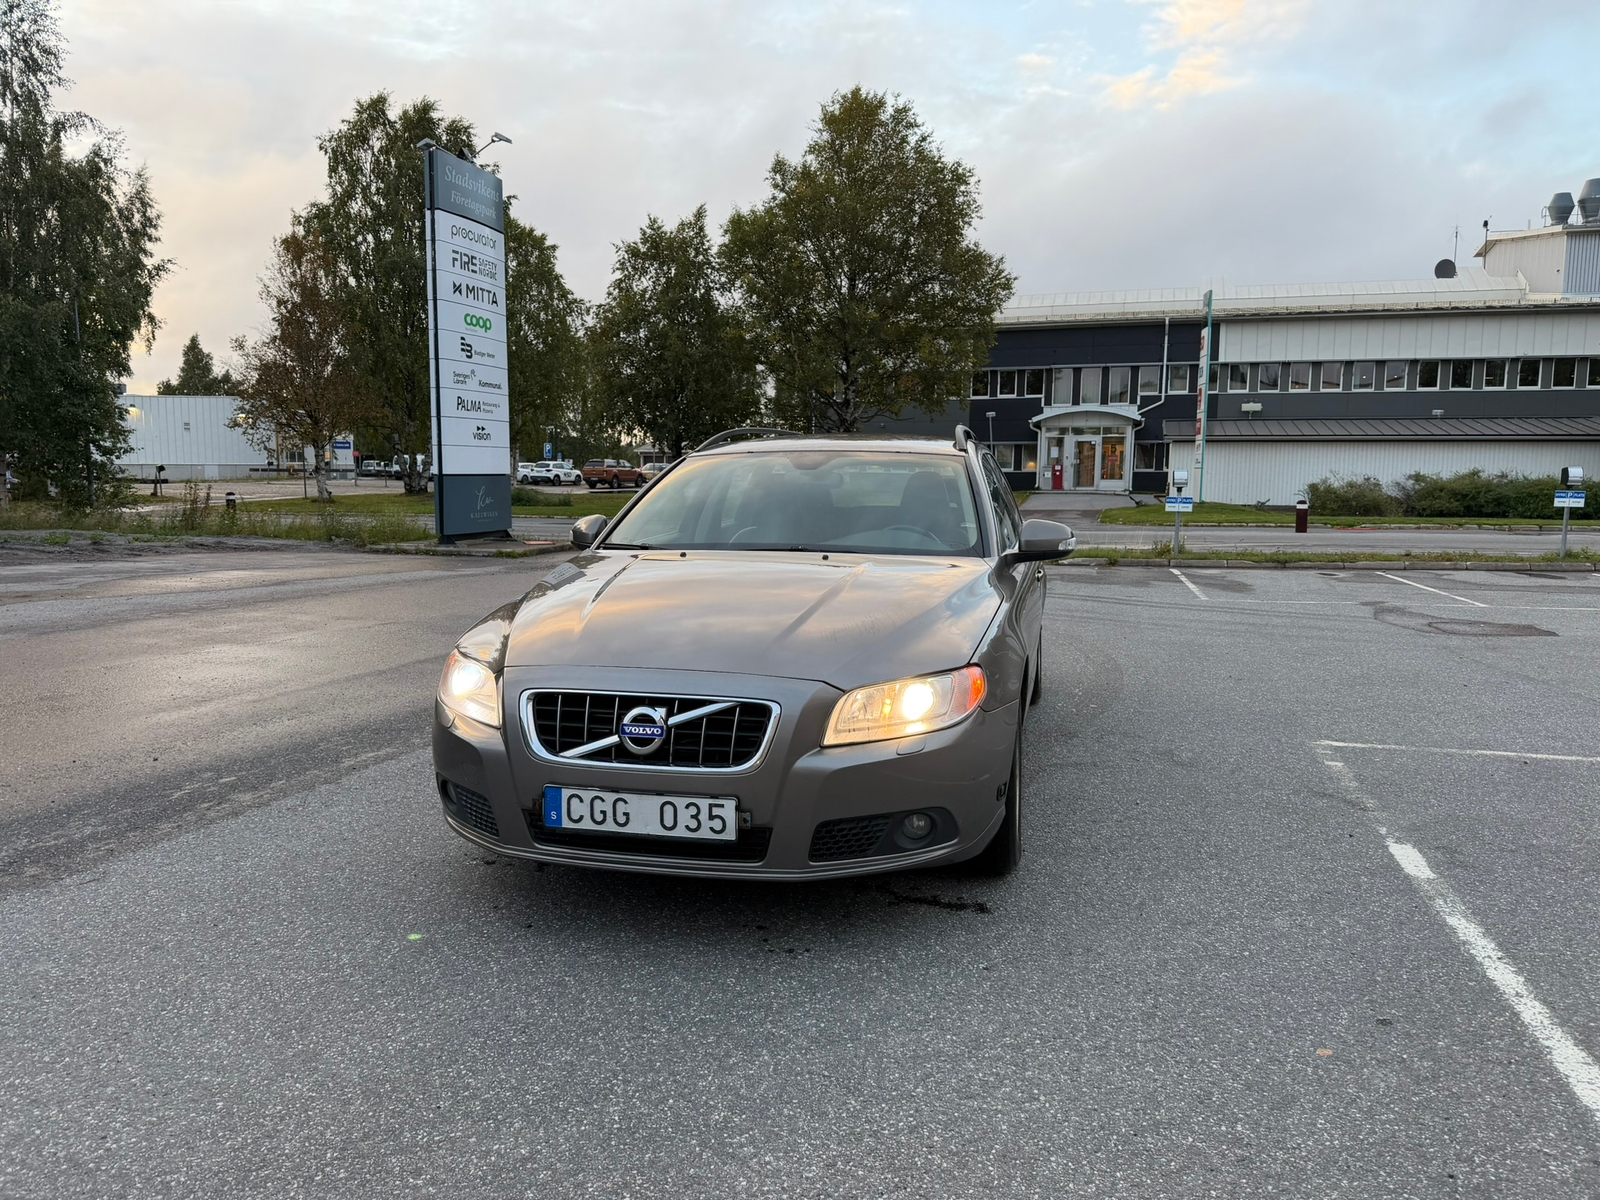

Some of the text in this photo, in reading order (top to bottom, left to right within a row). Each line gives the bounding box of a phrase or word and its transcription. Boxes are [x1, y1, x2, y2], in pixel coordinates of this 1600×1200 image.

[444, 165, 500, 202] Stadsvikens
[451, 190, 497, 219] Företagspark
[451, 224, 497, 250] procurator
[451, 249, 478, 275] FIRE
[478, 257, 498, 272] SAFETY
[478, 266, 498, 281] NORDIC
[465, 283, 499, 307] MITTA
[463, 312, 492, 333] coop
[456, 396, 482, 413] PALMA
[472, 431, 492, 441] vision
[623, 725, 662, 735] VOLVO
[551, 793, 727, 835] S CGG 035
